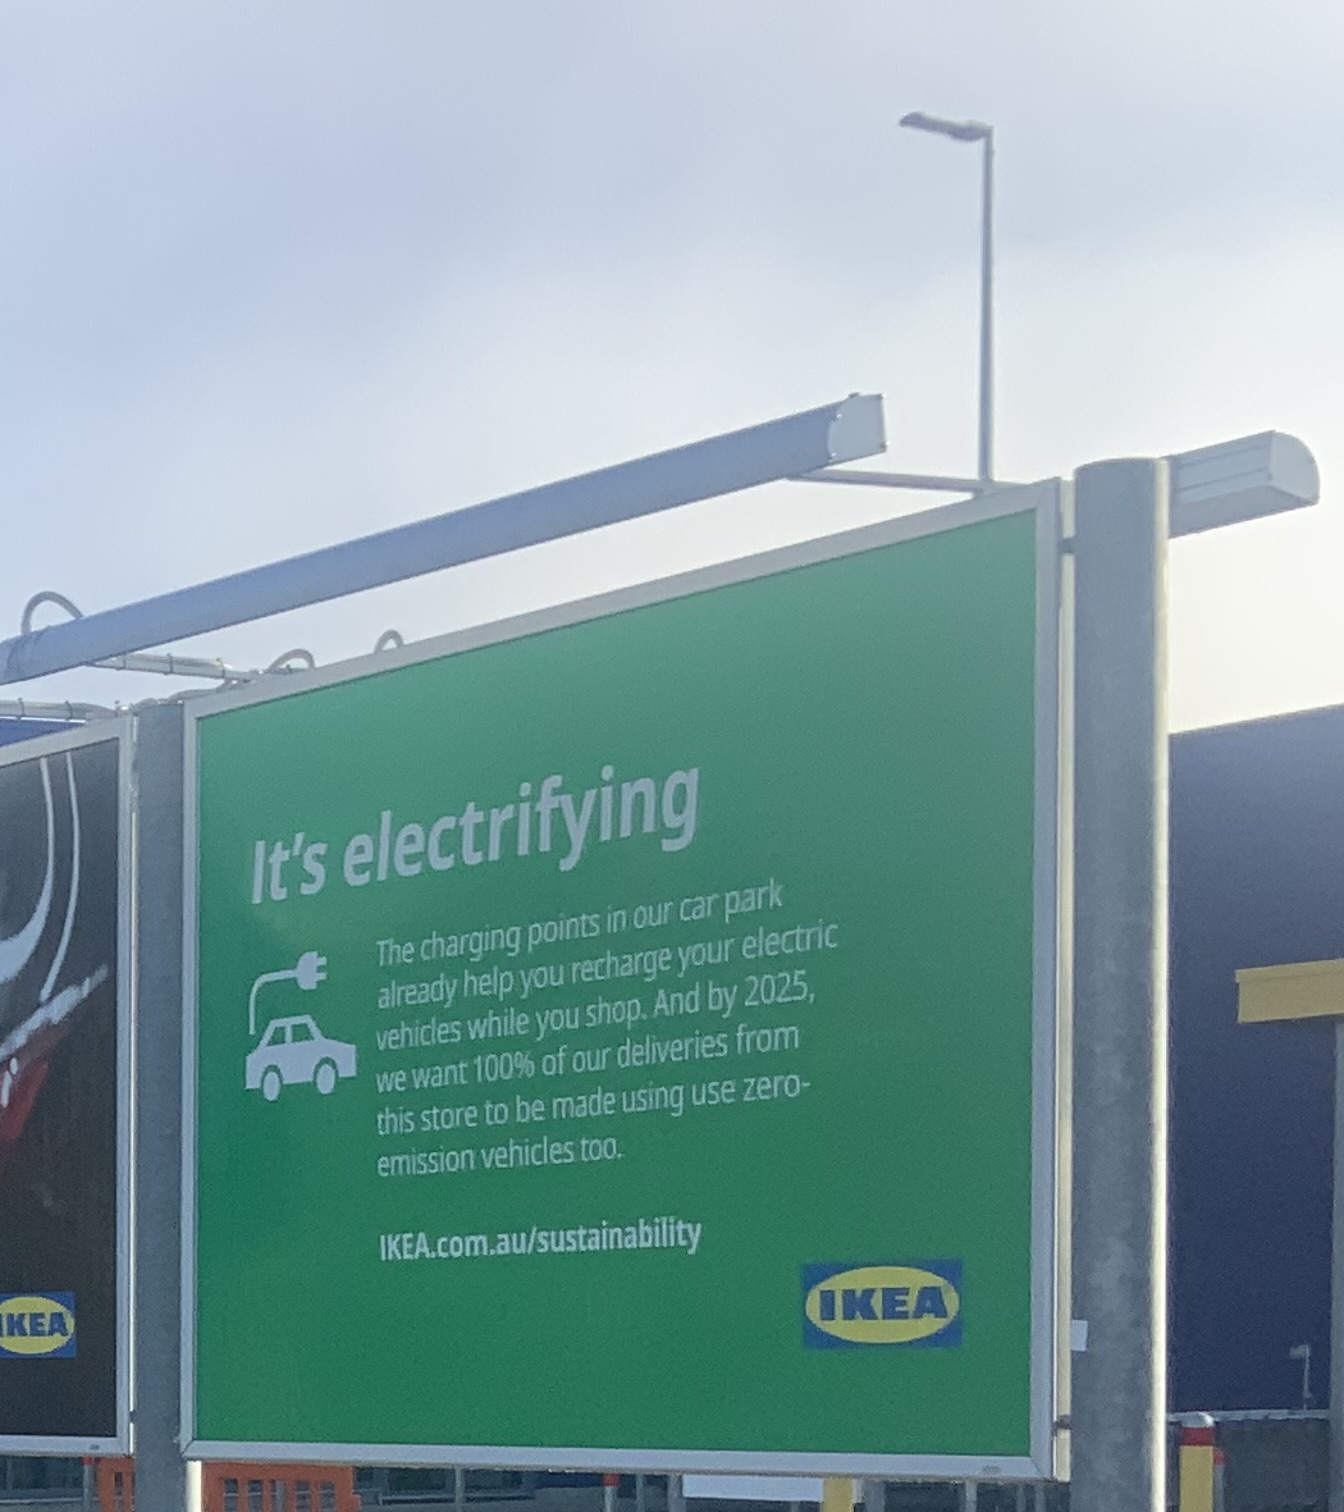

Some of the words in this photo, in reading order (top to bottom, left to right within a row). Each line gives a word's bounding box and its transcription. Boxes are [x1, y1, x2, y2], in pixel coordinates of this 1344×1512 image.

[251, 831, 329, 905] It's
[342, 764, 700, 888] electrifying
[375, 937, 415, 967] The
[420, 924, 521, 962] charging
[527, 912, 601, 954] points
[607, 905, 627, 934] in
[633, 900, 674, 929] our
[679, 893, 720, 922] car
[724, 877, 783, 925] park
[377, 973, 458, 1010] already
[463, 965, 514, 1002] help
[519, 963, 564, 999] you
[571, 948, 672, 984] recharge
[677, 938, 736, 978] your
[742, 918, 839, 960] electric
[376, 1017, 462, 1051] vehicles
[467, 1007, 530, 1040] while
[535, 1006, 579, 1042] you
[585, 996, 648, 1031] shop.
[653, 981, 700, 1017] And
[707, 979, 738, 1019] by
[744, 969, 815, 1006] 2025,
[375, 1069, 407, 1094] we
[412, 1060, 469, 1091] want
[474, 1050, 536, 1083] 100%
[541, 1045, 568, 1076] of
[572, 1047, 612, 1073] our
[617, 1029, 729, 1069] deliveries
[736, 1023, 800, 1055] from
[377, 1105, 415, 1136] this
[420, 1103, 479, 1132] store
[485, 1099, 509, 1126] to
[515, 1095, 546, 1123] be
[552, 1085, 616, 1120] made
[622, 1080, 684, 1117] using
[691, 1078, 736, 1107] use
[743, 1073, 811, 1102] zero-
[377, 1145, 475, 1177] emission
[481, 1135, 575, 1168] vehicles
[580, 1136, 624, 1162] too.
[379, 1215, 702, 1261] IKEA.com.au/sustainability
[819, 1285, 949, 1321] IKEA
